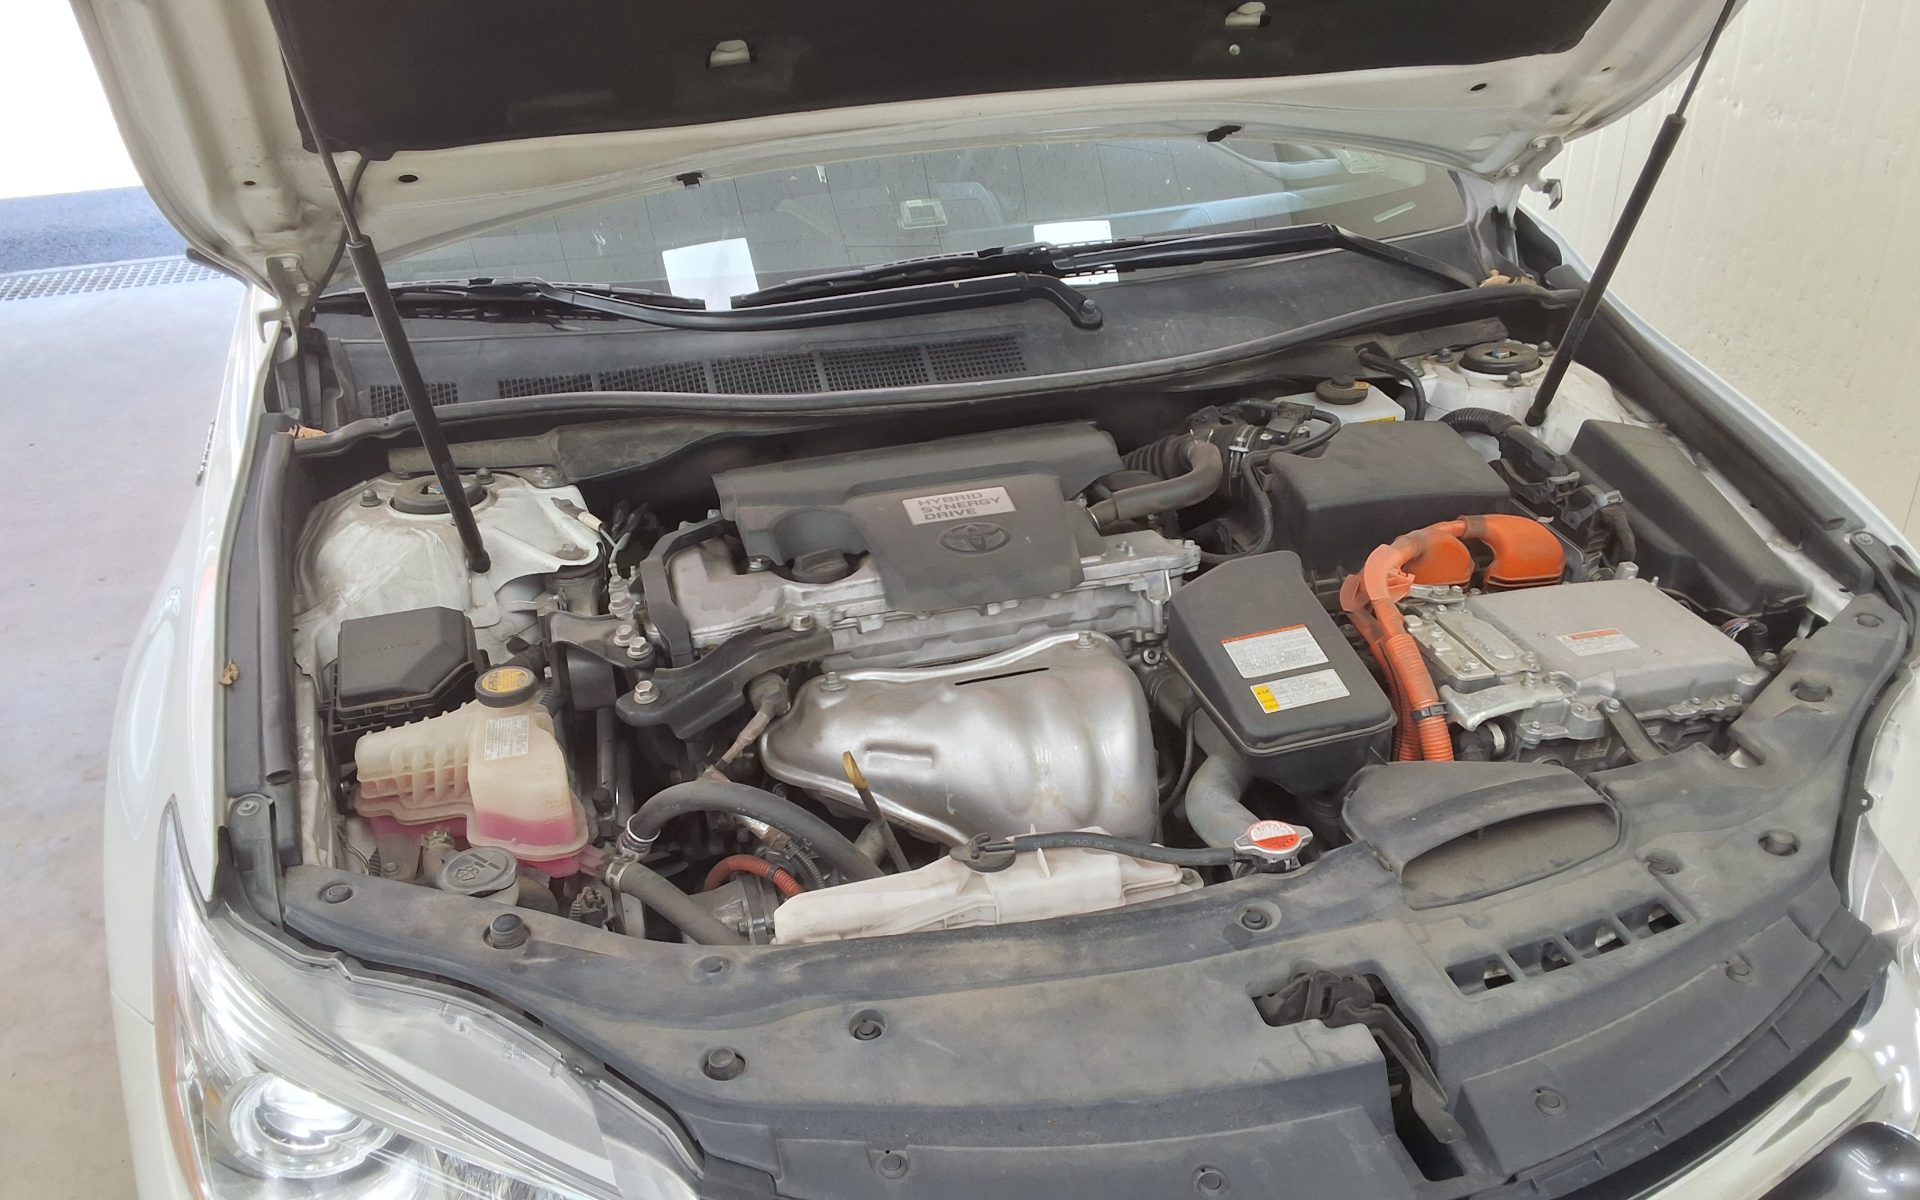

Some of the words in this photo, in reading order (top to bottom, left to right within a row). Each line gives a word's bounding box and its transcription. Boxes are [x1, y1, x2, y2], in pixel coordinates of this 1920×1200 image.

[918, 492, 983, 506] HYBRID
[921, 497, 1000, 513] SYNERGY
[924, 508, 977, 520] DRIVE
